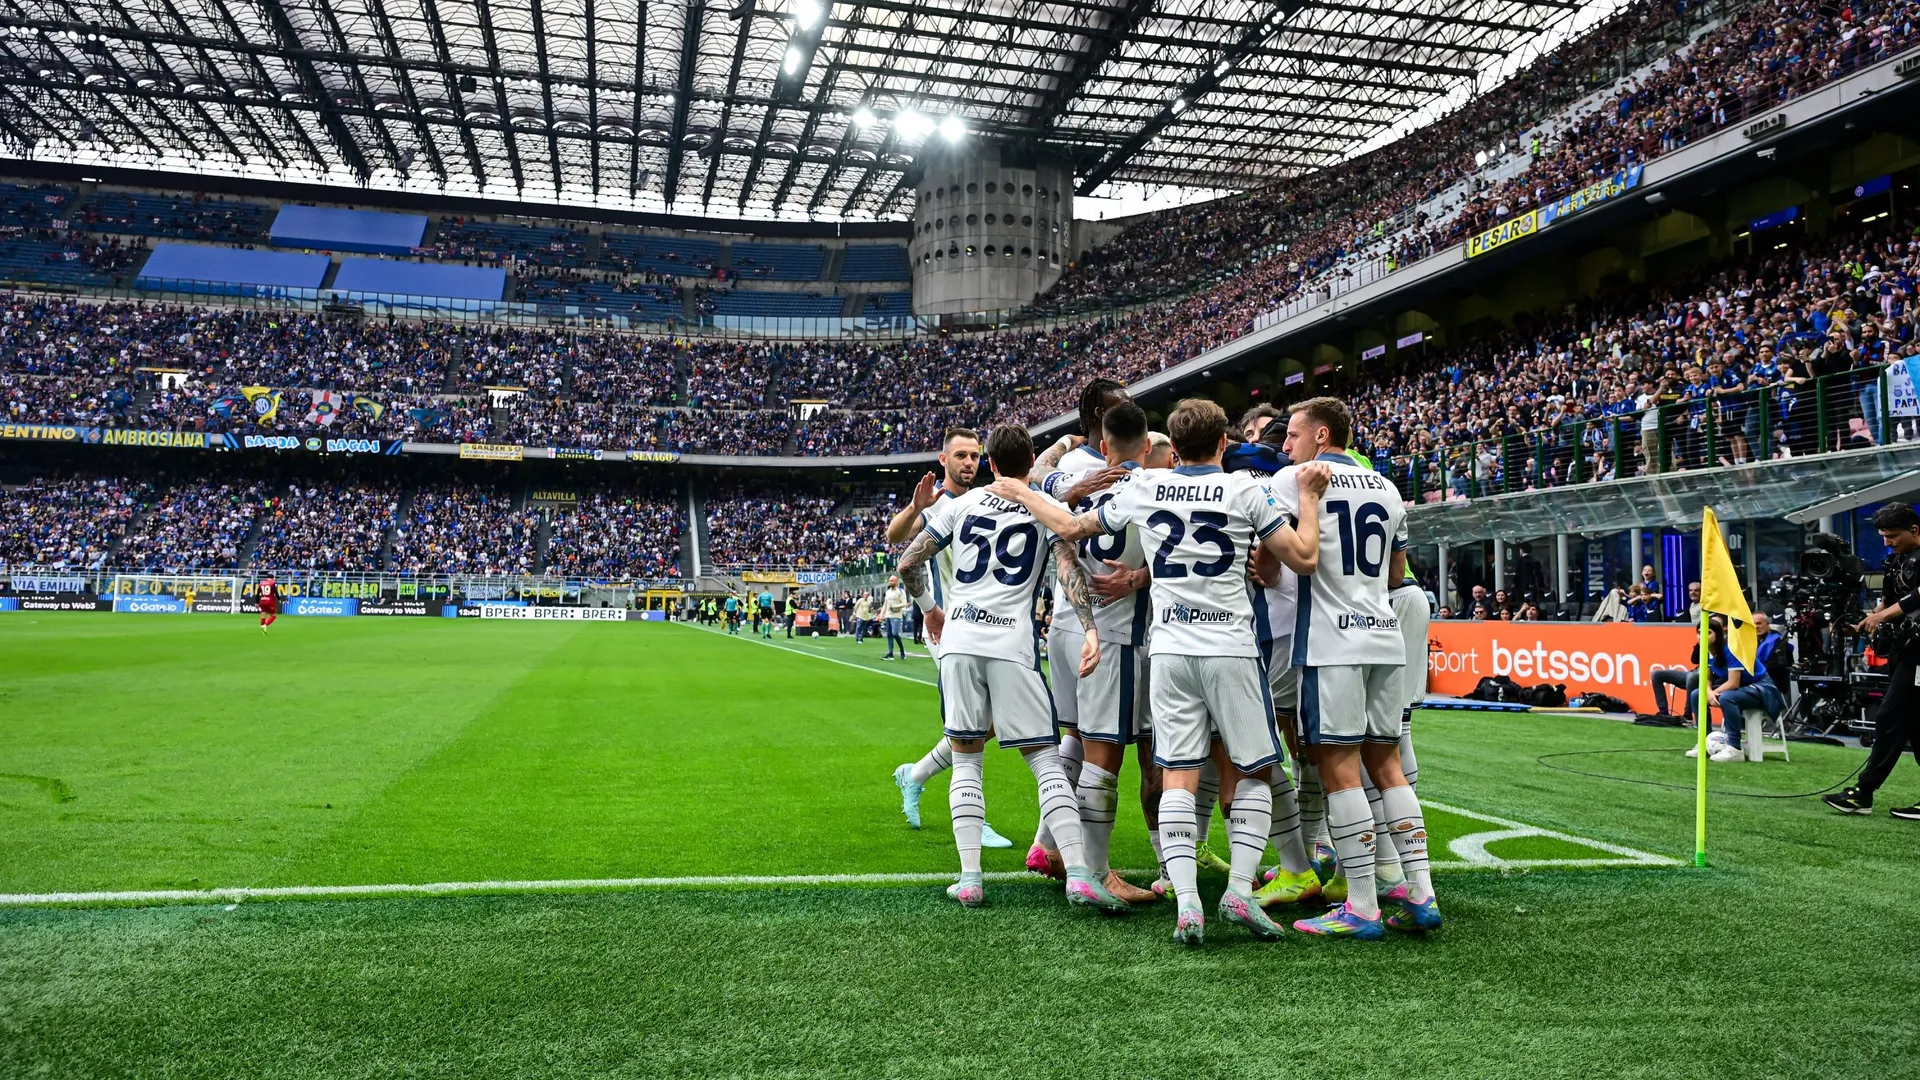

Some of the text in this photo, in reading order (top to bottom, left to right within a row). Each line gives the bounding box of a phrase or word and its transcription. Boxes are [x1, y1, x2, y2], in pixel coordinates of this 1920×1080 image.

[103, 429, 205, 448] AMBROSIANA
[632, 452, 673, 462] SENAGO
[1331, 474, 1388, 492] RATTESI
[532, 491, 576, 501] ALTAVILLA
[1155, 484, 1224, 503] BARELLA
[1326, 499, 1390, 578] 16
[1146, 509, 1236, 579] 23
[955, 514, 1039, 586] 59
[1588, 542, 1604, 592] INTER
[13, 580, 83, 591] VIA EMILIA
[23, 601, 60, 611] Gateway
[71, 602, 96, 610] Web3
[140, 602, 177, 611] Gate.io
[196, 603, 231, 613] Gateway
[307, 605, 342, 614] Gate.io
[360, 606, 394, 616] Gateway
[404, 607, 426, 615] Web3
[1041, 783, 1065, 795] INTER
[961, 792, 983, 801] INTER
[1167, 831, 1191, 839] INTER
[1404, 838, 1426, 846] INTER
